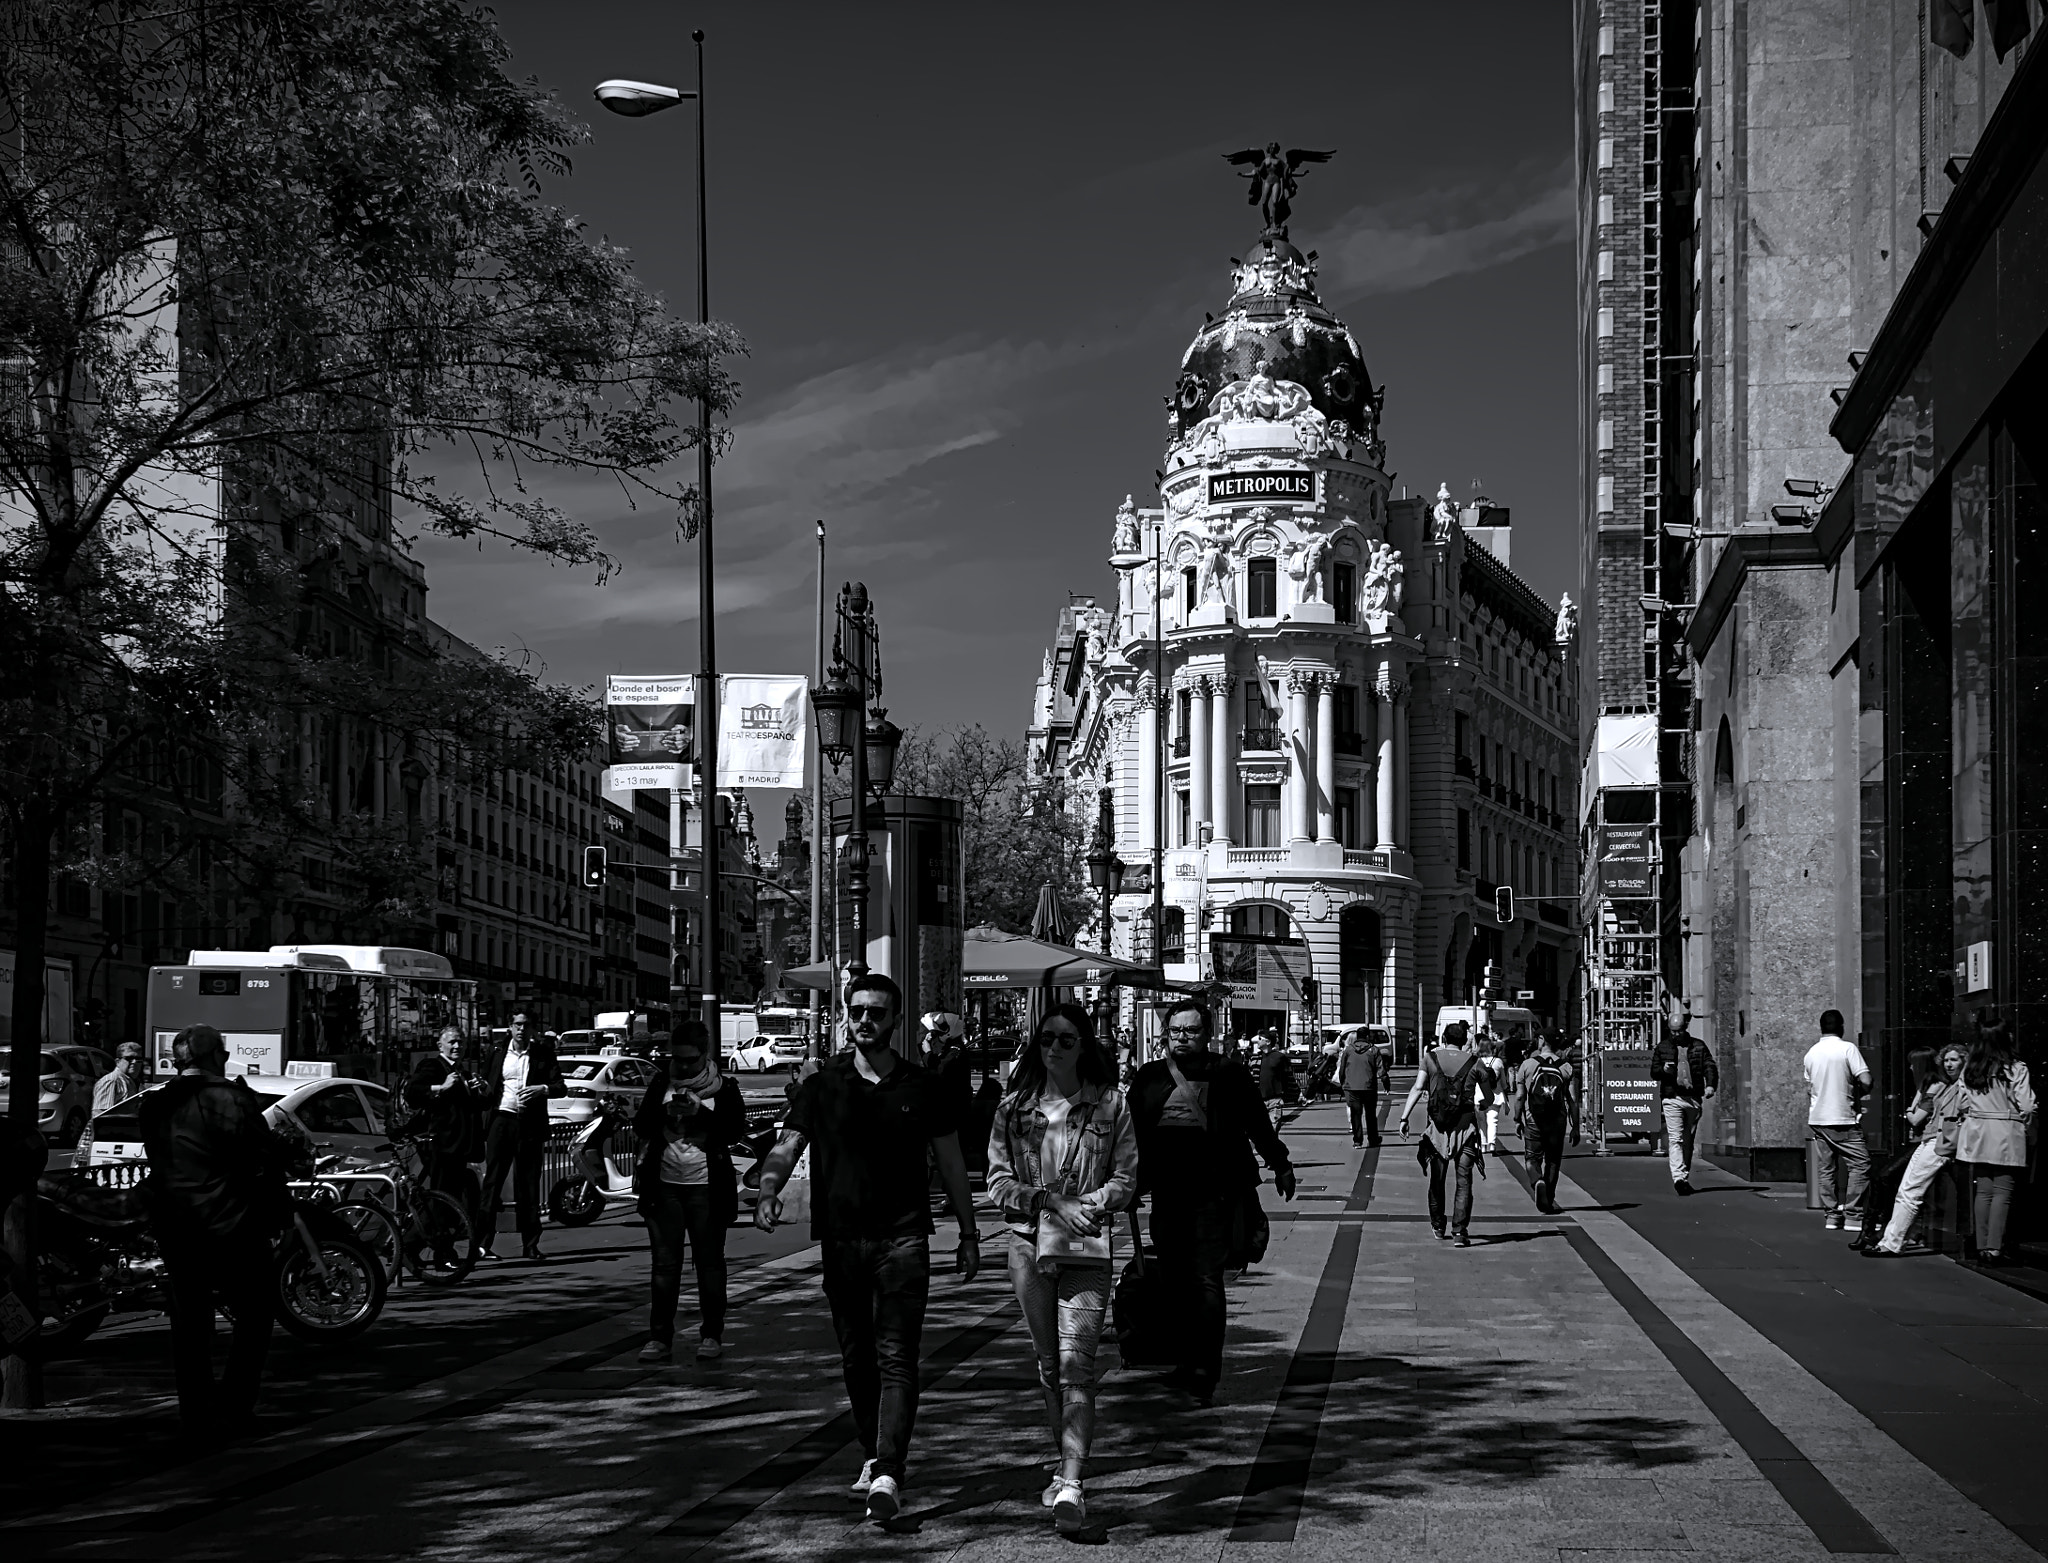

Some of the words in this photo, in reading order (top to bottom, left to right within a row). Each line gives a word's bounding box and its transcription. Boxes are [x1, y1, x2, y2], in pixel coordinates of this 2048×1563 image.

[1213, 476, 1309, 497] METROPOLIS
[611, 684, 643, 693] Donde
[645, 684, 654, 693] el
[625, 695, 659, 703] espesa
[614, 777, 620, 787] 3
[627, 776, 638, 785] 13
[639, 777, 659, 786] may
[747, 775, 781, 784] MADRID
[247, 980, 270, 988] 8793
[236, 1043, 272, 1059] hogar
[1606, 1080, 1626, 1088] FOOD
[1626, 1080, 1632, 1088] &
[1633, 1080, 1658, 1088] DRINKS
[1610, 1093, 1654, 1101] RESTAURANTE
[1613, 1104, 1652, 1114] CERVECERÍA
